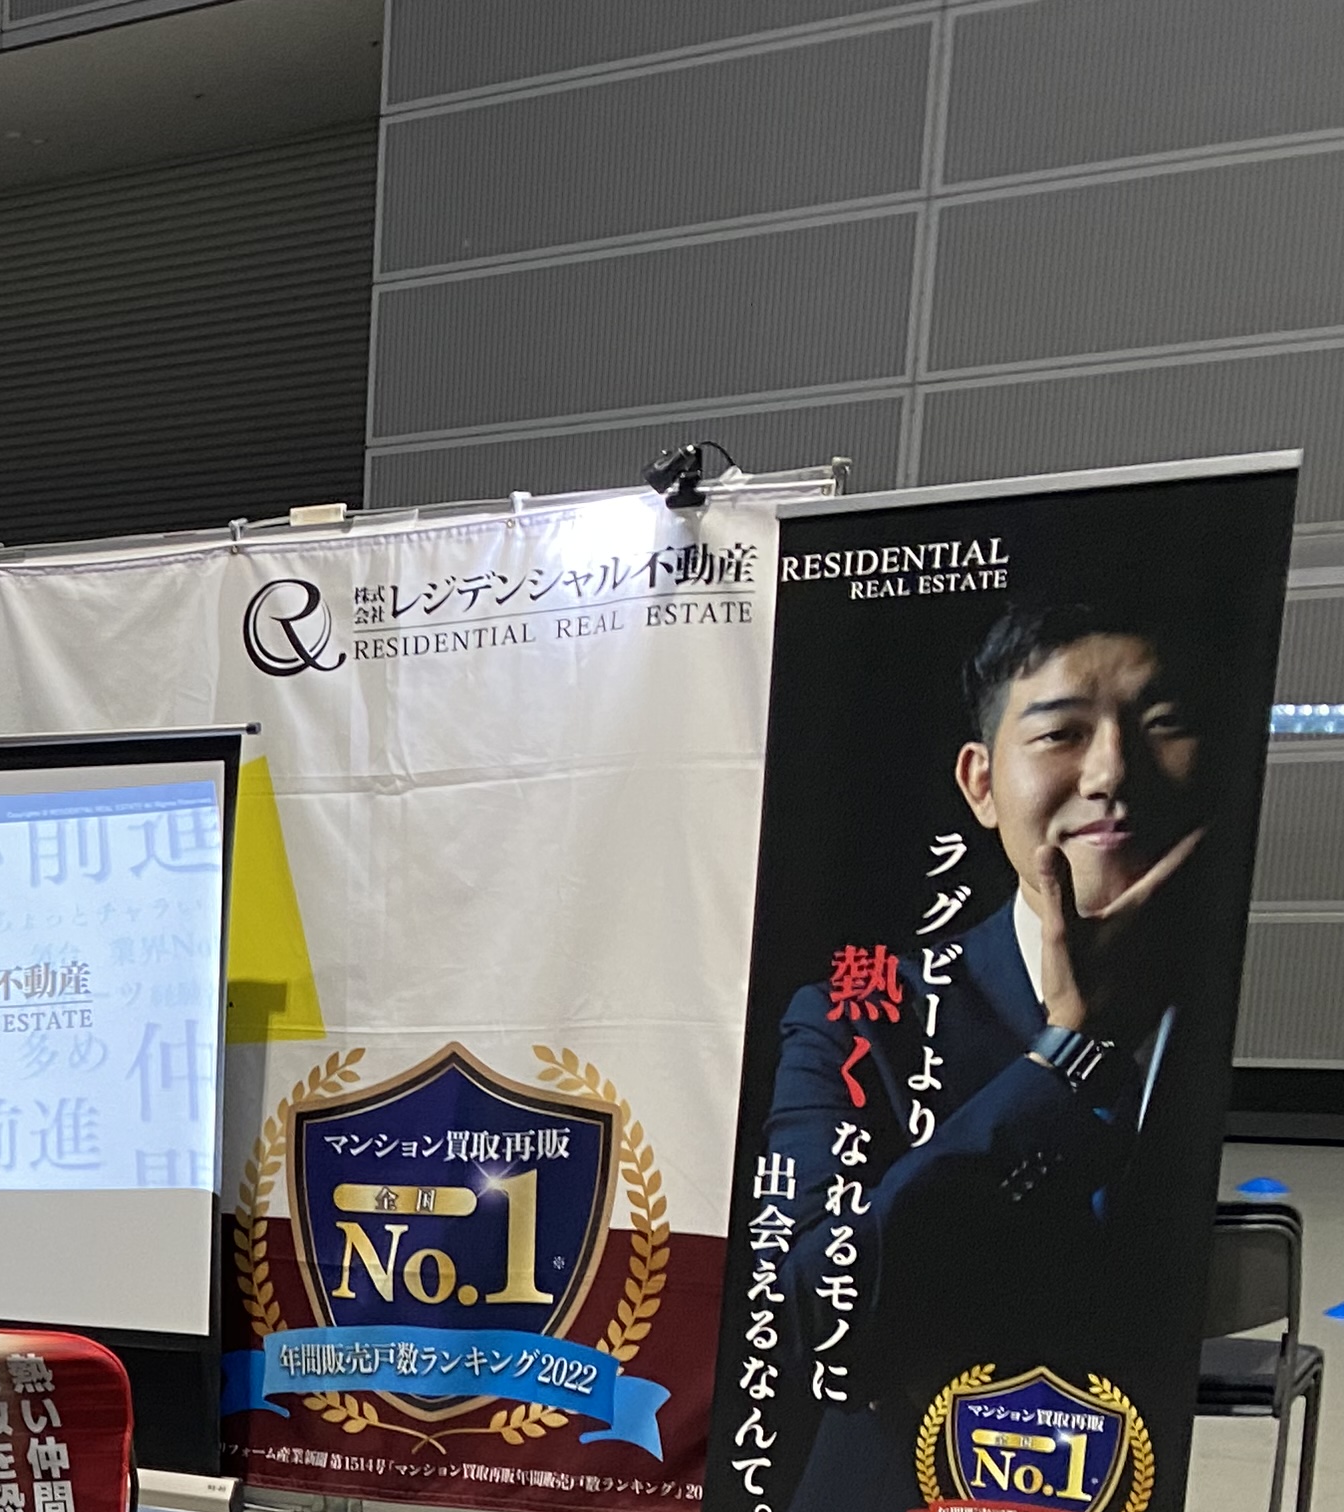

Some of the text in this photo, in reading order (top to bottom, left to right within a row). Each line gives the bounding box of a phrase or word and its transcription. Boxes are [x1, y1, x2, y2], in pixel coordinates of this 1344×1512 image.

[389, 543, 758, 620] レジデンシャル不動産
[781, 536, 1010, 584] RESIDENTIAL
[849, 567, 1009, 600] REAL ESTATE
[353, 600, 755, 663] RESIDENTIAL REAL ESTATE
[2, 1008, 94, 1032] ESTATE
[906, 831, 972, 1150] ラグビーより
[323, 1127, 572, 1164] マンション買取再販
[812, 942, 904, 1403] 熱くなれるモノに
[330, 1168, 555, 1308] No.1
[278, 1341, 599, 1397] 年間販売戸数ランキング2022
[967, 1401, 1106, 1434] マンション買取再販
[970, 1431, 1094, 1502] No.1
